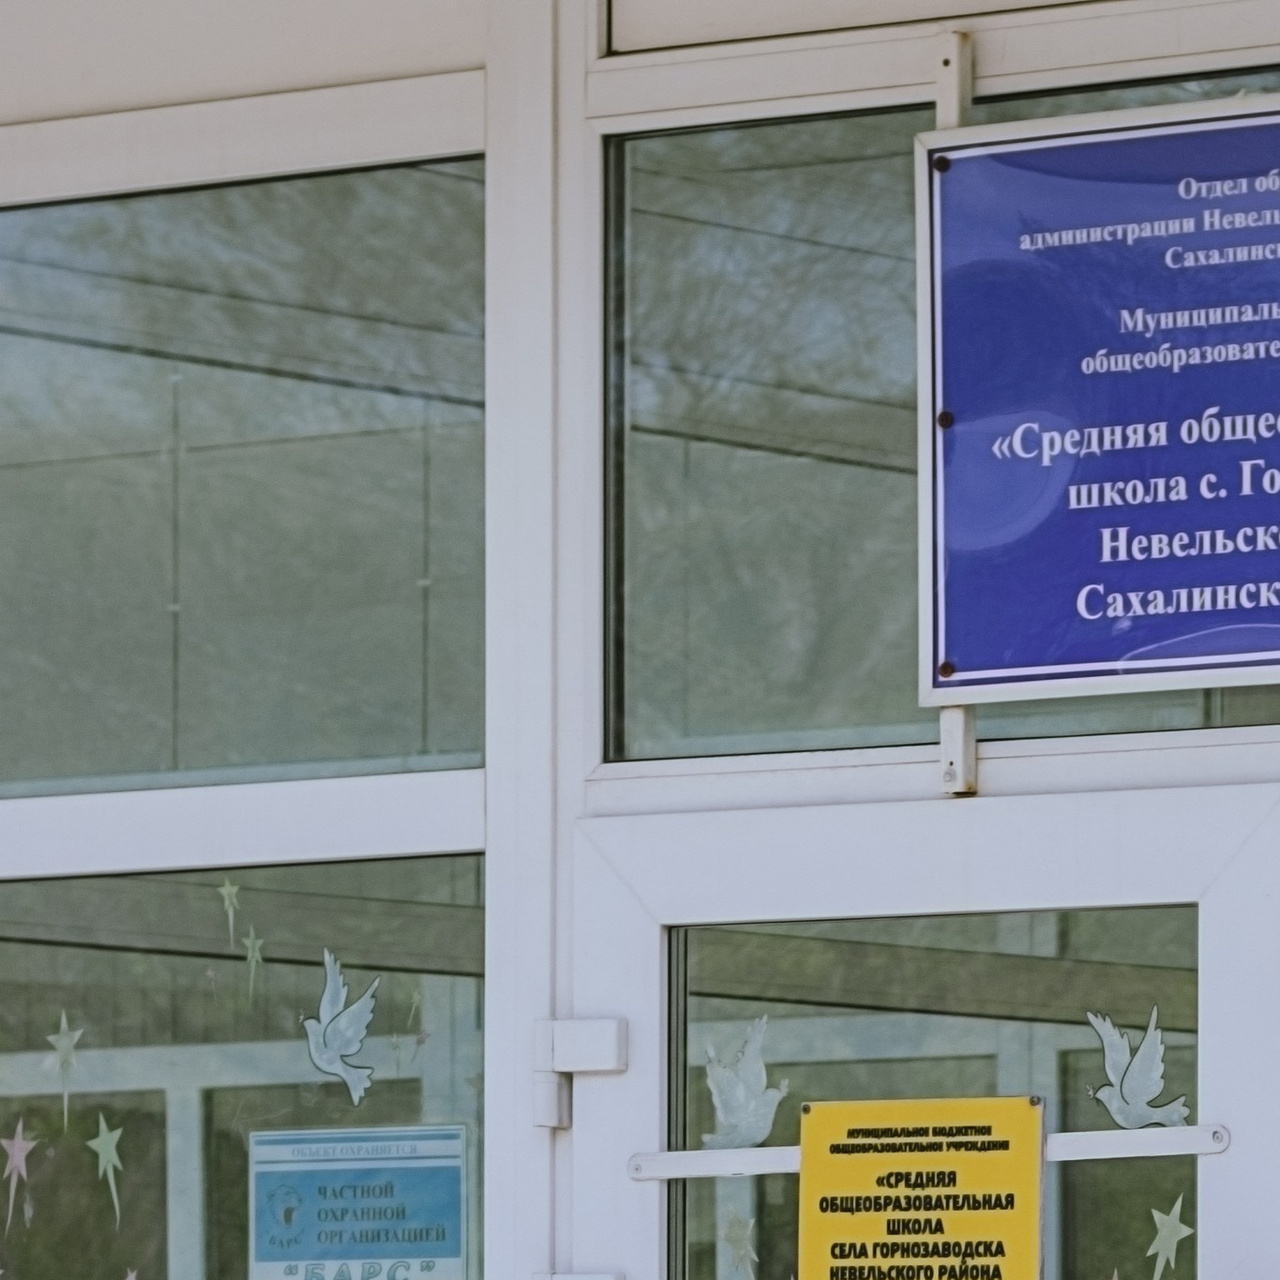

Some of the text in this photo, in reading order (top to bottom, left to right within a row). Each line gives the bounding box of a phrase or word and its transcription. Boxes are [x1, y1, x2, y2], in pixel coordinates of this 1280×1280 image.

[1178, 176, 1249, 200] Отдел
[1019, 217, 1196, 252] администрации
[991, 416, 1169, 467] «Средняя
[1068, 473, 1189, 511] школа
[1198, 473, 1228, 499] с.
[317, 1181, 395, 1200] ЧАСТНОЙ
[876, 1170, 957, 1191] «СРЕДНЯЯ
[316, 1203, 407, 1223] ОХРАННОЙ
[818, 1192, 1016, 1215] ОБЩЕОБРАЗОВАТЕЛЬНАЯ
[316, 1224, 447, 1245] ОРГАНИЗАЦИЕЙ
[886, 1217, 945, 1236] ШКОЛА
[830, 1240, 1006, 1261] СЕЛА ГОРНОЗАВОДСКА
